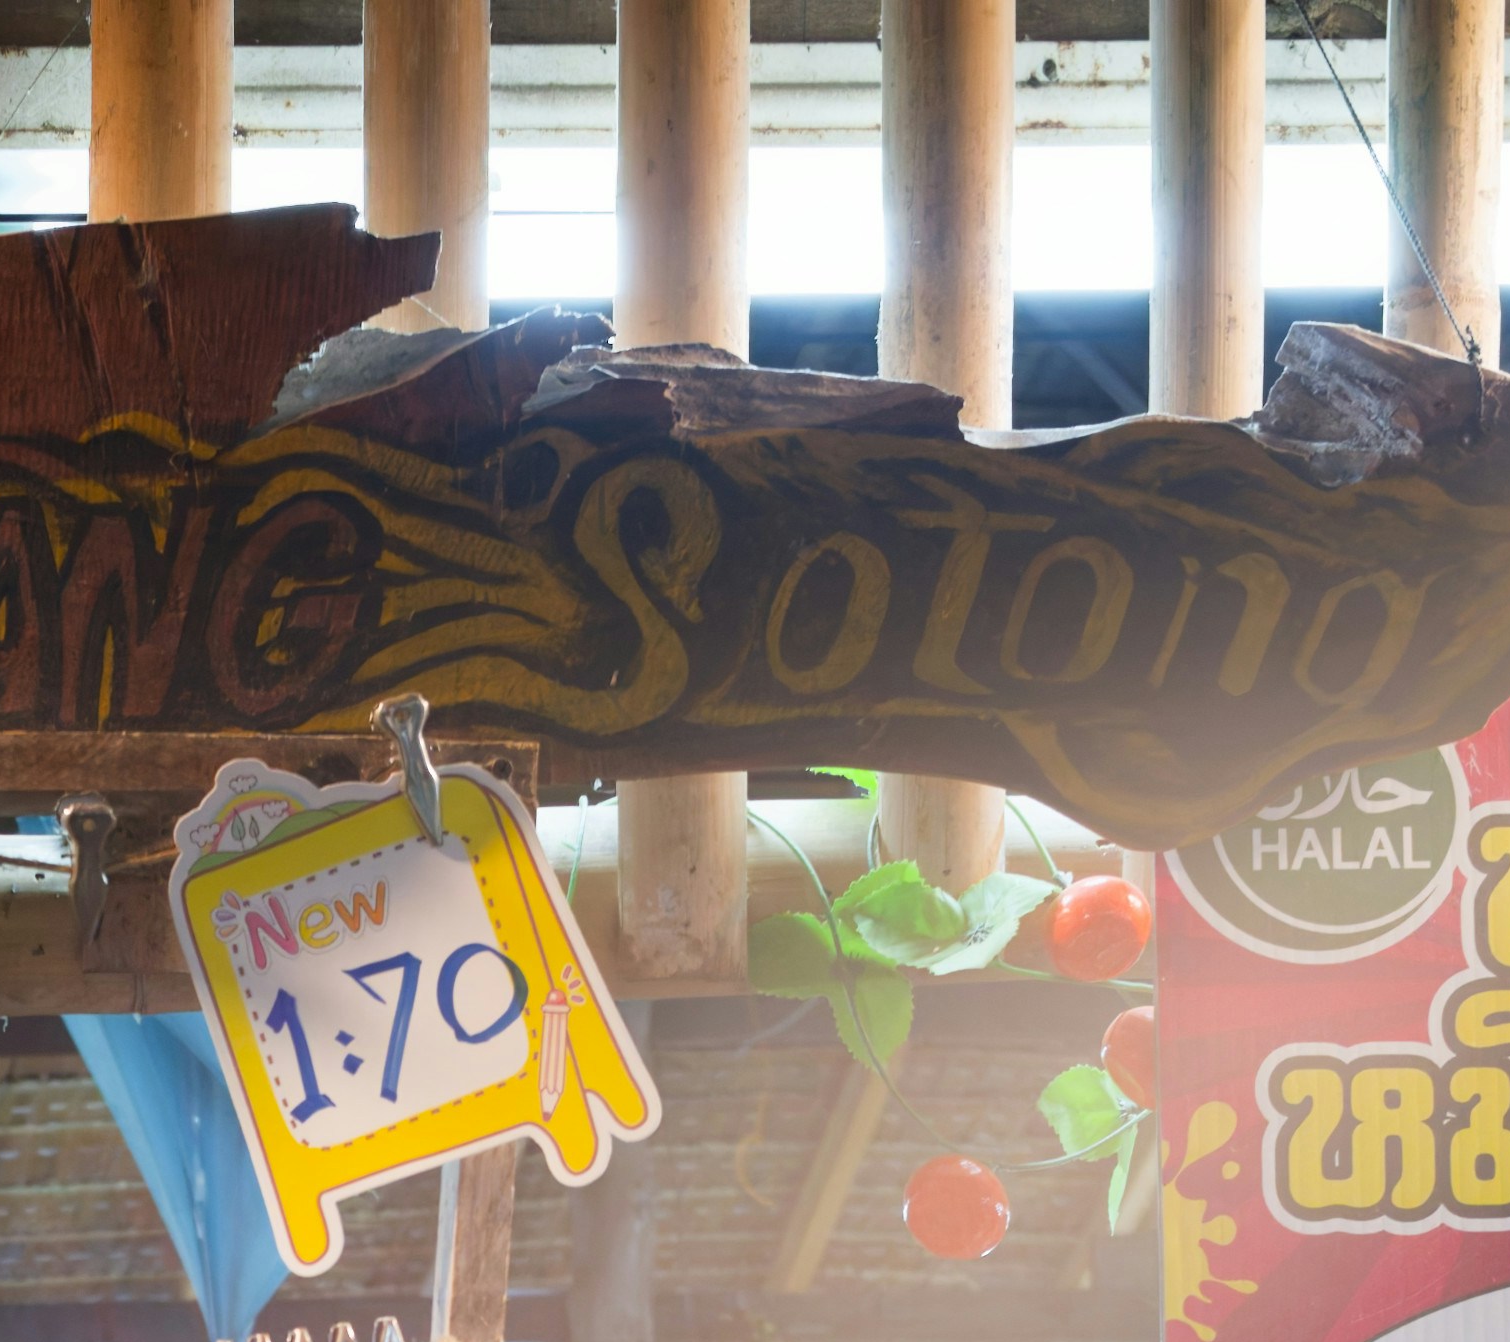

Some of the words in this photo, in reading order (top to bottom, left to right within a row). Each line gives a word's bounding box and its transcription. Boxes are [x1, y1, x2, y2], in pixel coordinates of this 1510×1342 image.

[1251, 825, 1432, 871] HALAL
[242, 880, 388, 970] New
[265, 942, 530, 1124] 1:70
